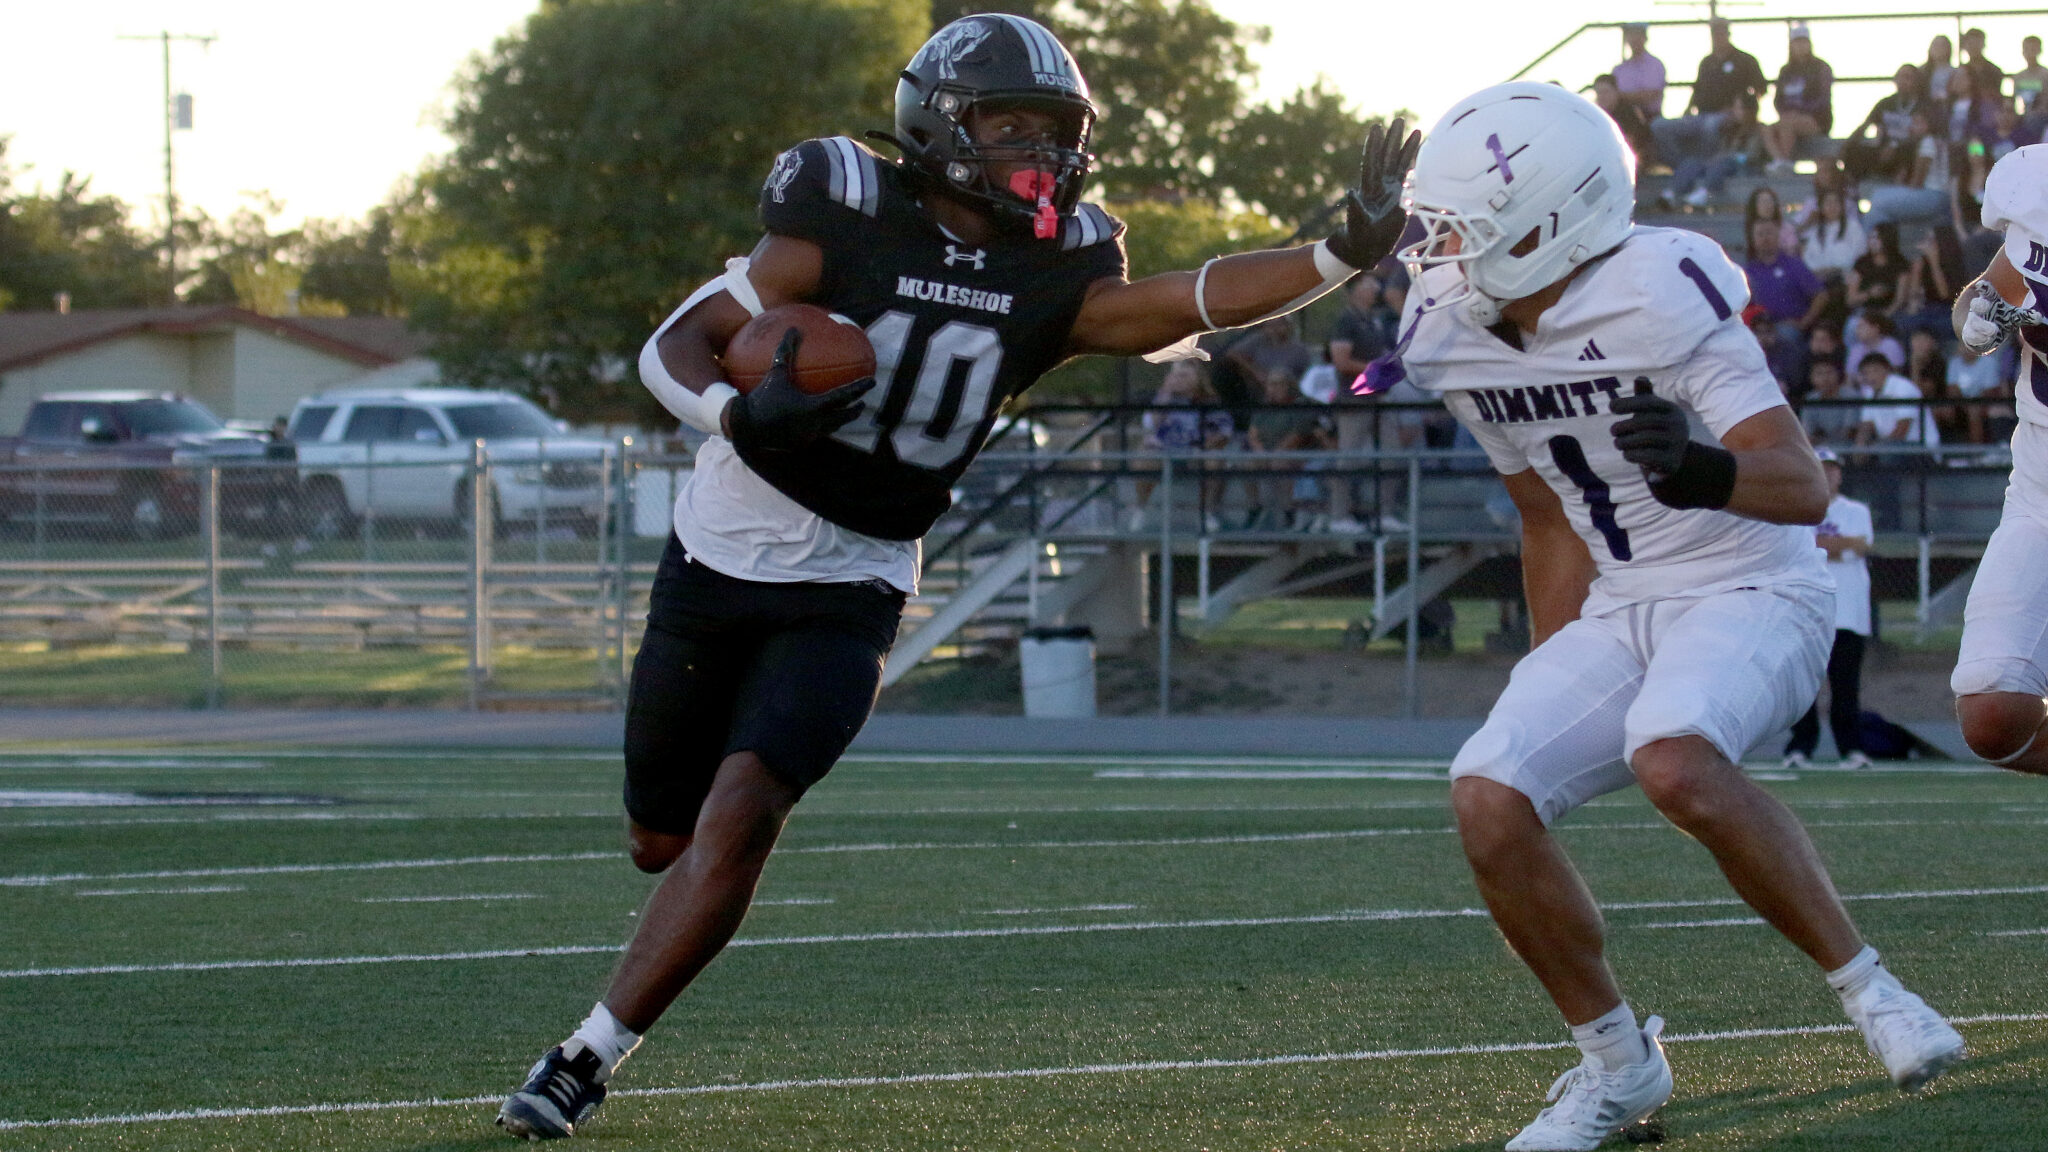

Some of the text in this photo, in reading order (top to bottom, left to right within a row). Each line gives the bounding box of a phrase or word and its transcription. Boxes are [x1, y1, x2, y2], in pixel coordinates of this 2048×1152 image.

[1485, 132, 1515, 186] 1
[896, 276, 1014, 315] MULESHOE
[1678, 257, 1733, 322] 1
[831, 309, 1004, 471] 10
[1466, 376, 1622, 423] DIMMITT
[1548, 434, 1633, 562] 1
